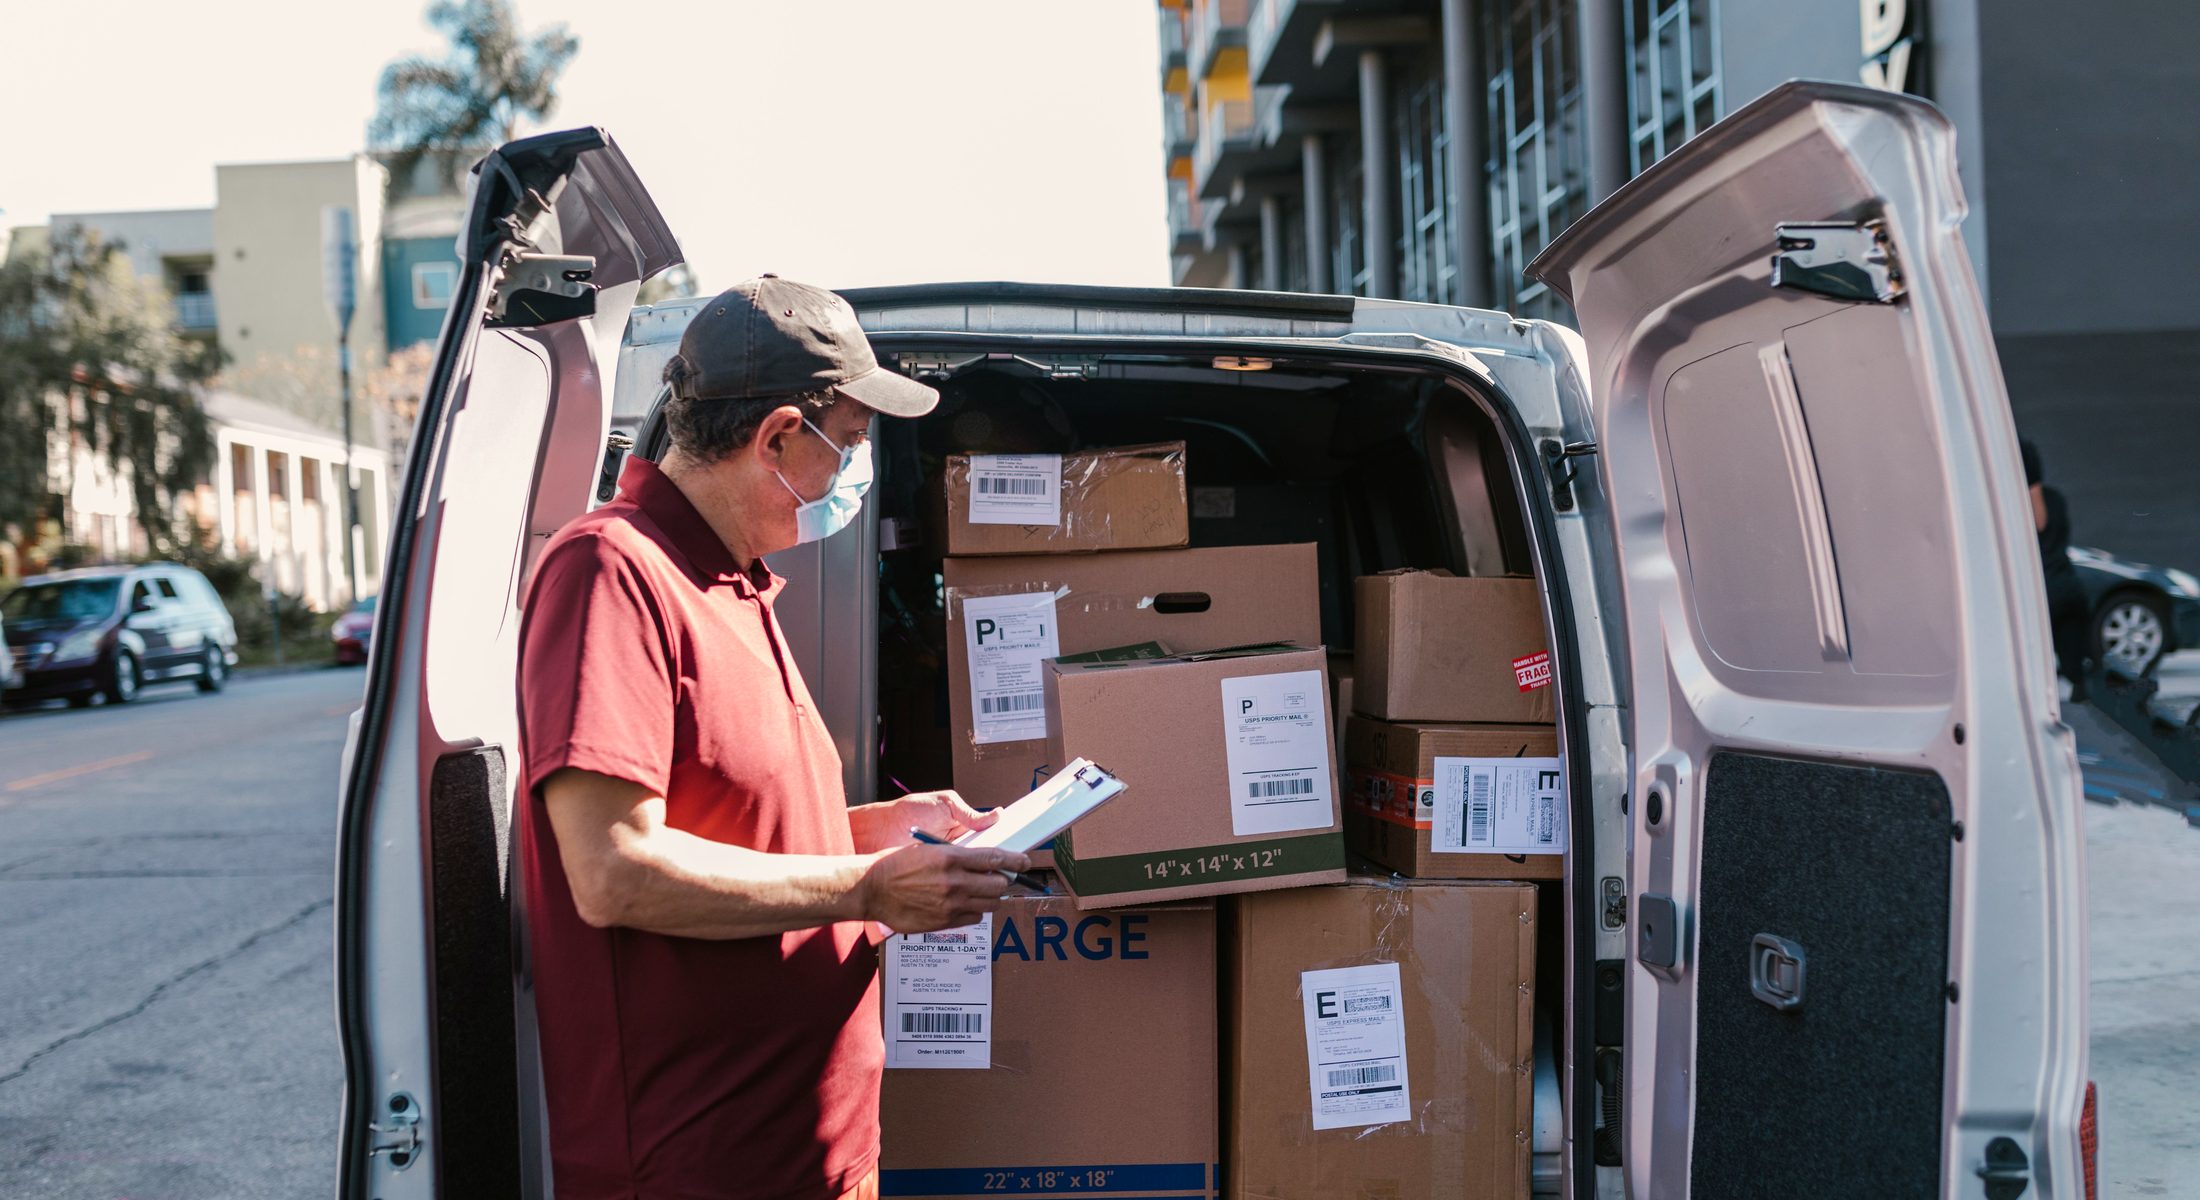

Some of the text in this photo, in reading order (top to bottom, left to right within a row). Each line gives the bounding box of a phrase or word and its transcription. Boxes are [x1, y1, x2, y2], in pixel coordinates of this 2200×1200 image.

[976, 619, 996, 645] P
[1514, 654, 1548, 668] HANDLE WITH
[1518, 663, 1551, 682] FRAGI
[1530, 679, 1548, 688] THANK
[1242, 700, 1253, 714] P
[1144, 848, 1282, 880] 14" x 14" x 12"
[992, 915, 1149, 962] ARGE
[1316, 991, 1338, 1019] E
[983, 1170, 1114, 1190] 22" x 18" x 18"
